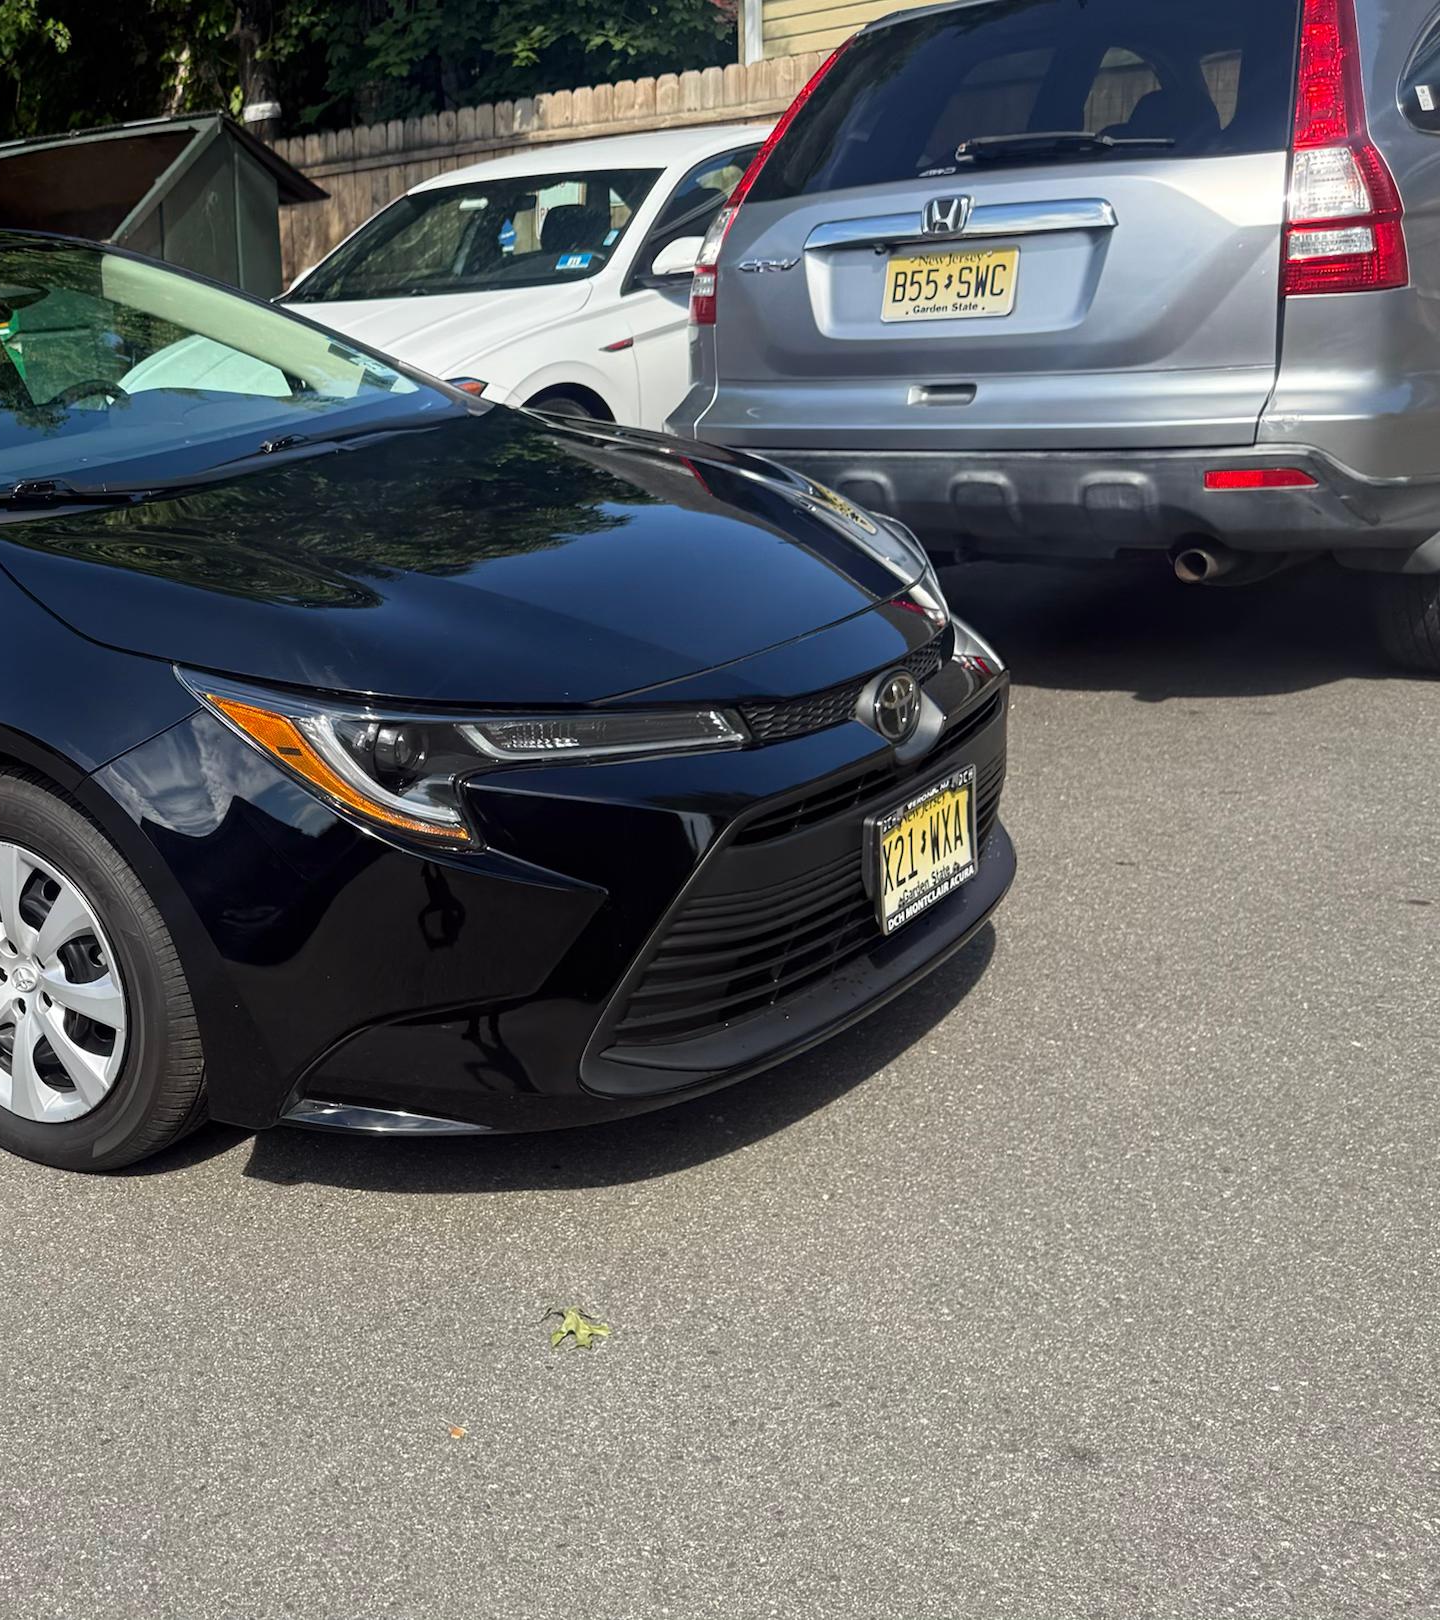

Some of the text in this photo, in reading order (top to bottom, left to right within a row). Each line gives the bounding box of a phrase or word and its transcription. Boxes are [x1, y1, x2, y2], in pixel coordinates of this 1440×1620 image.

[918, 253, 984, 267] New Jersey
[913, 302, 978, 314] Garden State
[904, 865, 950, 900] Garden State
[888, 864, 975, 931] DCH MONTCLAIR ACURA
